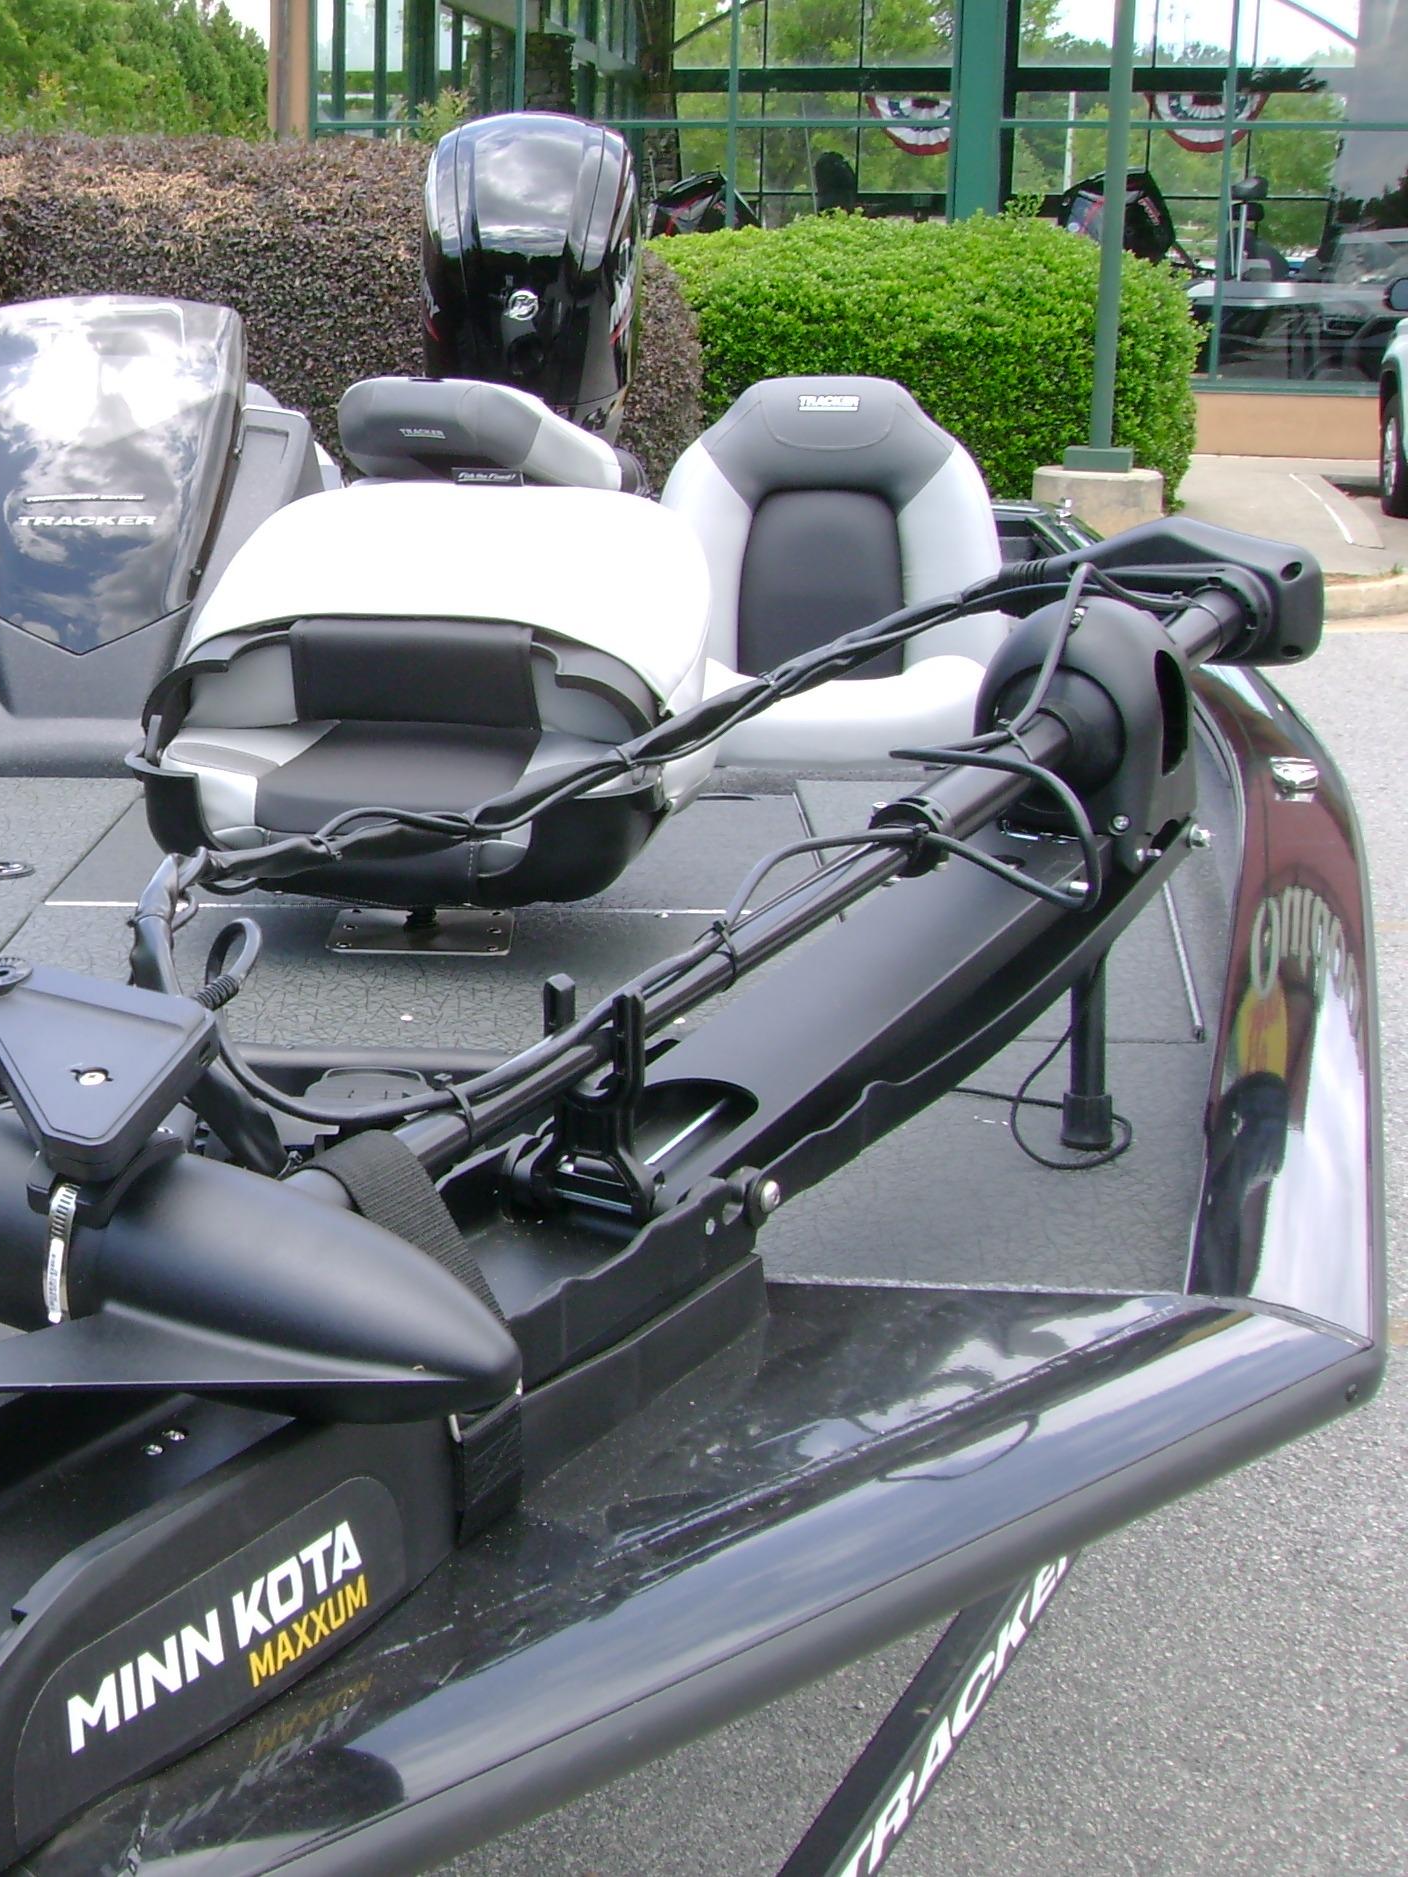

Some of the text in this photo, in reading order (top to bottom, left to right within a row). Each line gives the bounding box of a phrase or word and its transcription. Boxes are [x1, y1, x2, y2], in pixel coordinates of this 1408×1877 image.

[18, 515, 157, 526] TRACKER
[66, 1608, 225, 1754] MINN
[231, 1520, 362, 1649] KOTA
[247, 1574, 369, 1688] MAXXUM
[839, 1555, 1068, 1877] RACKE
